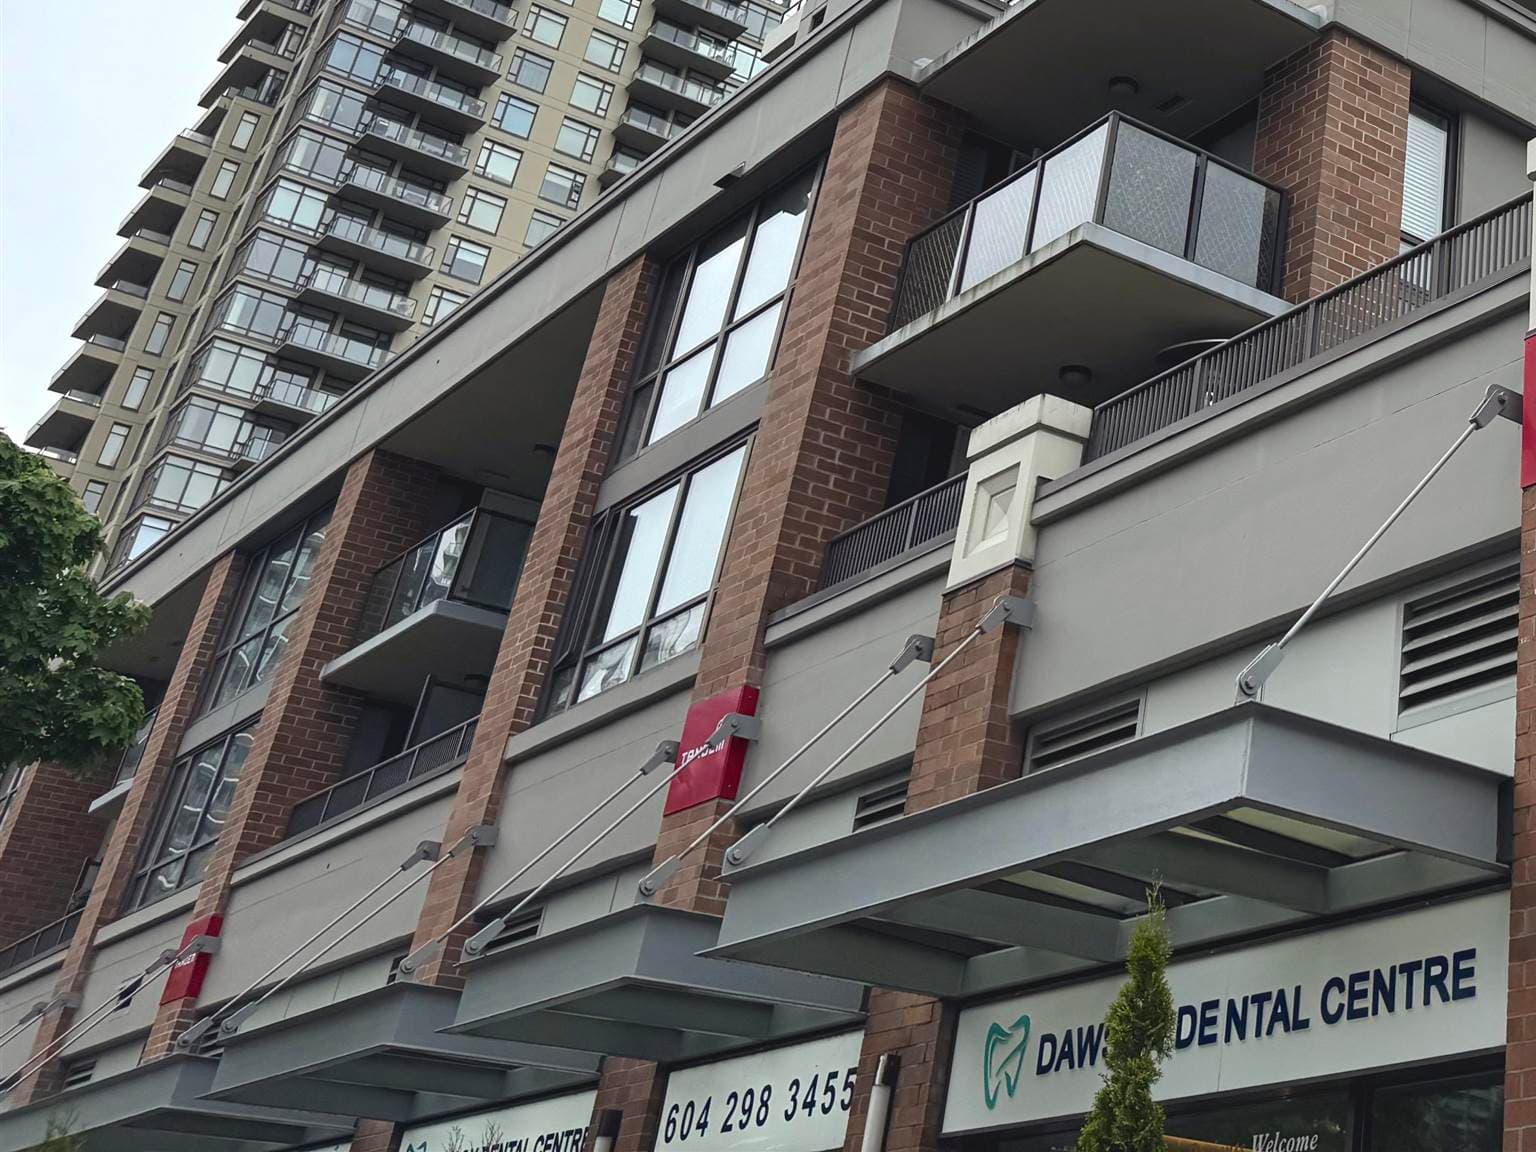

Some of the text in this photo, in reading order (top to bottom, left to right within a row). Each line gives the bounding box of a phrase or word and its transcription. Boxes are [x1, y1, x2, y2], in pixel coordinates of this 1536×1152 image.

[1174, 984, 1311, 1050] DENTAL
[1320, 947, 1477, 1026] CENTRE
[664, 1066, 859, 1144] 604 298 3455
[1252, 1131, 1320, 1152] Welcome
